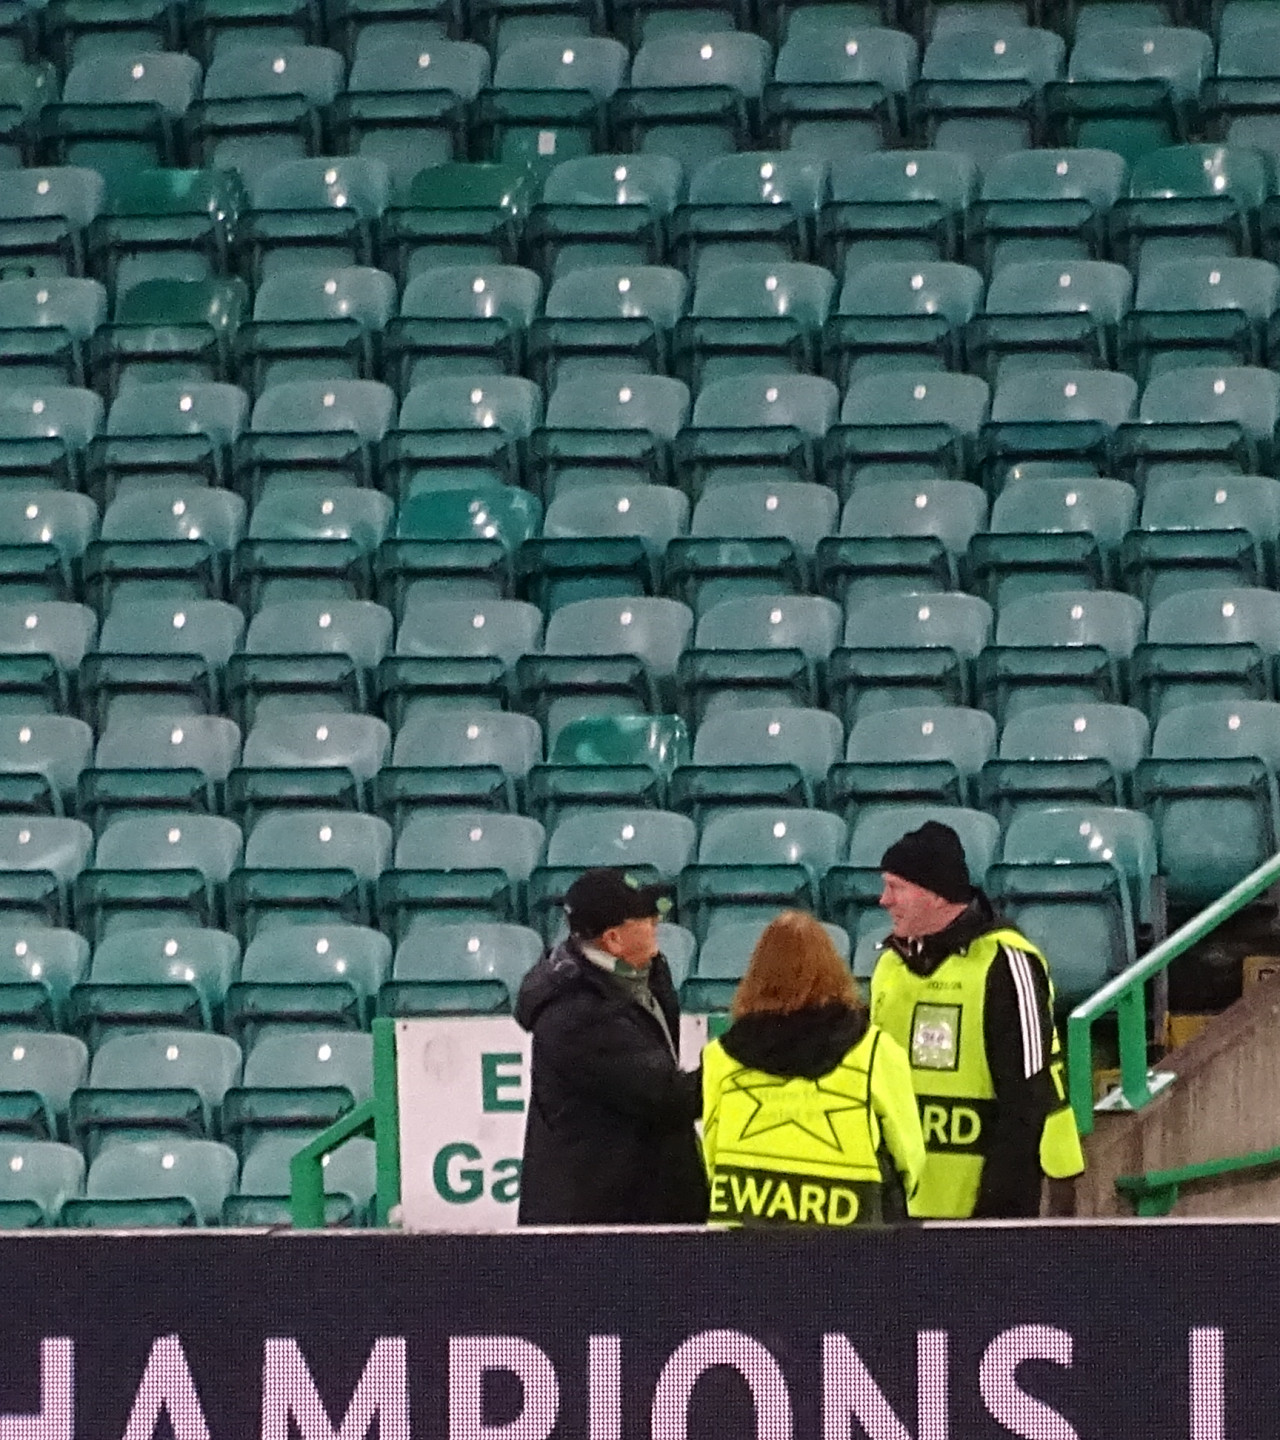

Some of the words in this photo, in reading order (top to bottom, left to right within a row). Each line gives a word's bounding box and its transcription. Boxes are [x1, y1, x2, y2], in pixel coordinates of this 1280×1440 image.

[481, 1052, 525, 1113] E
[923, 1104, 982, 1145] RD
[433, 1142, 523, 1205] Ga
[710, 1174, 859, 1226] EWARD
